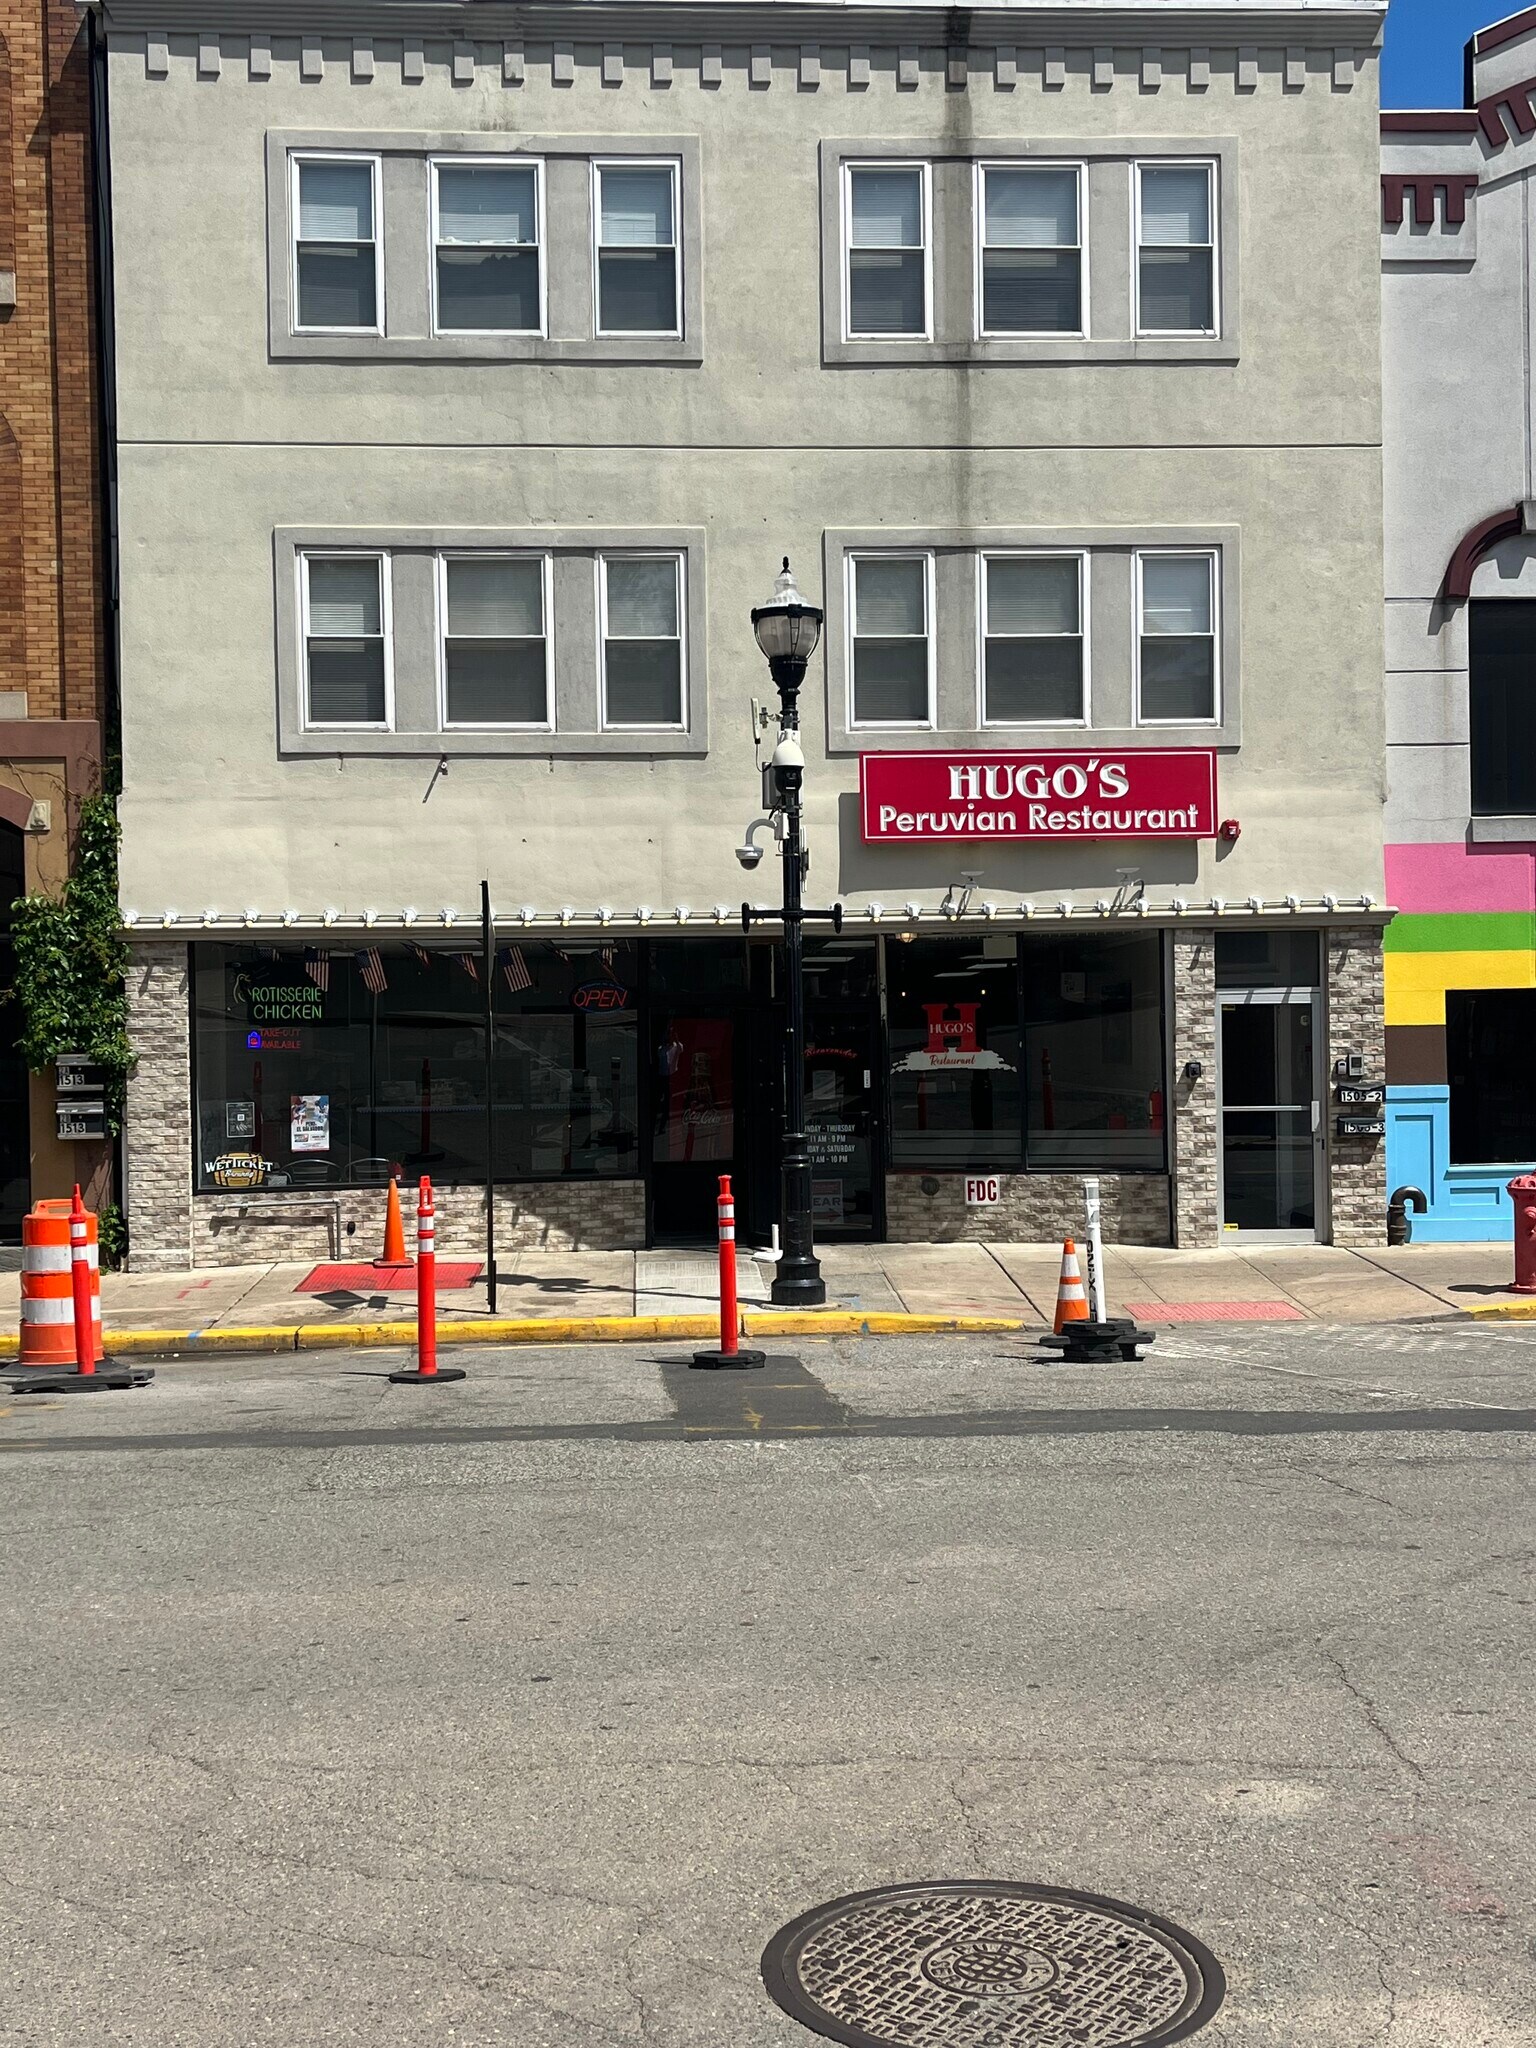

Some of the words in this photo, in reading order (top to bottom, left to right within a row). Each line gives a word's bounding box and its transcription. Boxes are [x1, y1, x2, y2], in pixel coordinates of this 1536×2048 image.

[948, 759, 1130, 800] HUGO'S
[879, 803, 1016, 832] Peruvian
[1028, 803, 1199, 830] Restaurant
[252, 986, 322, 1002] ROTISSERIE
[573, 989, 628, 1007] OPEN
[253, 1004, 322, 1020] CHICKEN
[929, 1022, 974, 1034] HUGO'S
[929, 1054, 977, 1066] Restaurant
[59, 1074, 84, 1086] 1513
[1341, 1090, 1382, 1103] 1505-2
[60, 1123, 86, 1134] 1513
[826, 1124, 856, 1133] THURSDAY
[826, 1145, 856, 1153] SATURDAY
[966, 1179, 998, 1202] FDC
